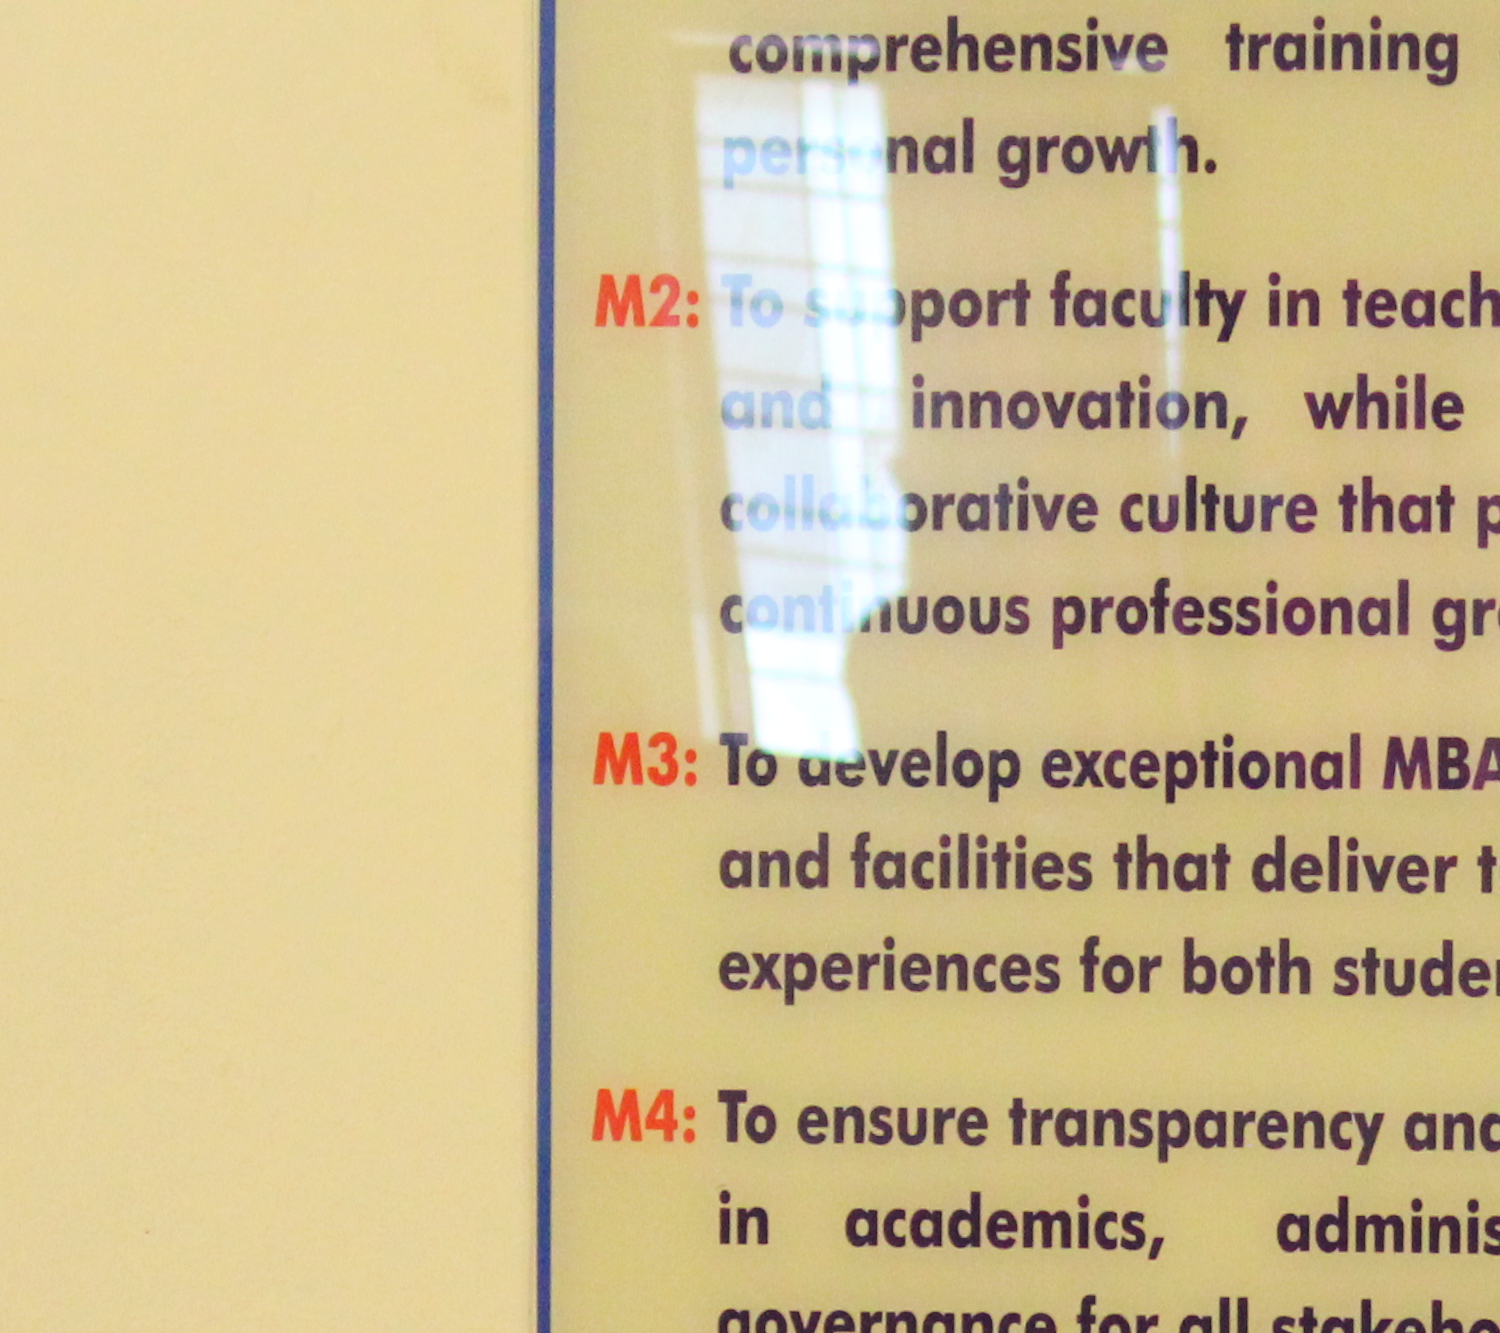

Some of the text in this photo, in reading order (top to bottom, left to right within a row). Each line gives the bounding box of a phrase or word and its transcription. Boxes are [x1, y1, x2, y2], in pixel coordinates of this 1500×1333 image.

[728, 14, 1169, 83] comprehensive
[1224, 14, 1460, 88] training
[996, 116, 1218, 190] growth.
[595, 273, 700, 329] M2:
[720, 272, 784, 329] To
[1048, 268, 1248, 344] faculty
[1267, 271, 1322, 328] in
[720, 373, 832, 430] and
[912, 373, 1248, 441] innovation,
[1303, 371, 1466, 433] while
[1119, 473, 1319, 535] culture
[1337, 474, 1457, 535] that
[1051, 576, 1411, 651] professional
[592, 731, 698, 788] M3:
[719, 732, 779, 788] To
[797, 729, 1022, 804] develop
[1040, 731, 1363, 806] exceptional
[719, 831, 830, 890] and
[849, 830, 1094, 893] facilities
[1112, 833, 1232, 894] that
[1250, 833, 1459, 896] deliver
[718, 935, 1062, 1007] experiences
[1078, 934, 1164, 996] for
[1182, 935, 1312, 997] both
[591, 1087, 697, 1144] M4:
[717, 1088, 778, 1146] To
[796, 1104, 990, 1148] ensure
[1007, 1096, 1386, 1167] transparency
[718, 1188, 770, 1247] in
[844, 1190, 1165, 1262] academics,
